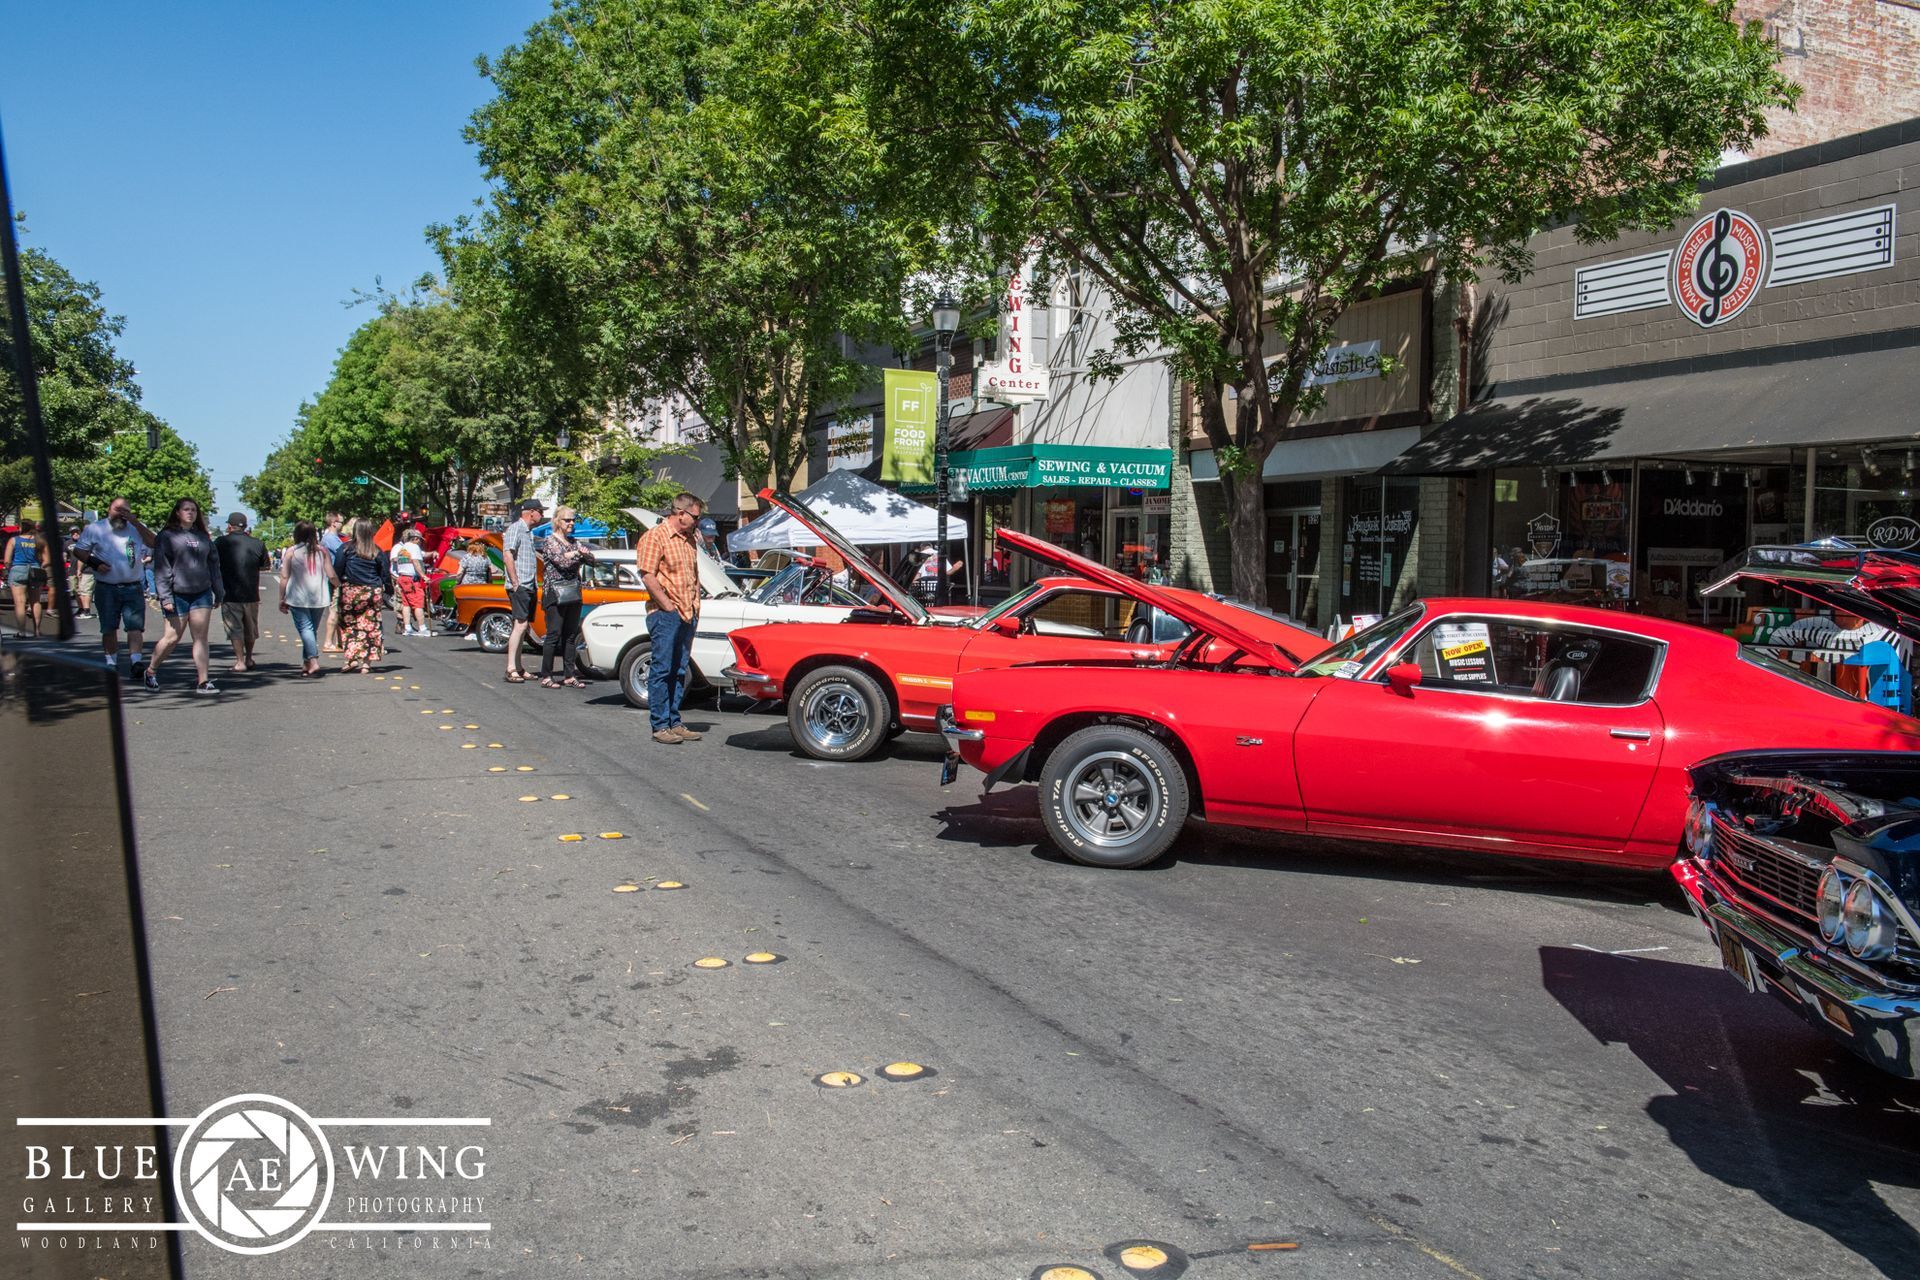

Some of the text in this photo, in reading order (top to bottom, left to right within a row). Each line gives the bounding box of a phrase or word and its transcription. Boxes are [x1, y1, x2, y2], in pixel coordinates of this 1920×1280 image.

[1681, 224, 1757, 310] MAIN STREET MUSIC CENTER
[988, 376, 1041, 389] Center
[902, 399, 920, 412] FF
[894, 428, 926, 439] FOOD
[894, 438, 925, 447] FRONT
[1038, 459, 1166, 476] SEWING & VACUUM
[966, 466, 1009, 484] VACUUM
[1042, 475, 1157, 487] SALES REPAIR CLASSES
[1872, 526, 1916, 544] RDM
[1445, 641, 1484, 657] NOW OPEN!
[1449, 657, 1485, 667] MUSIC LESSONS
[1453, 672, 1487, 681] MUSIC SUPPLIES
